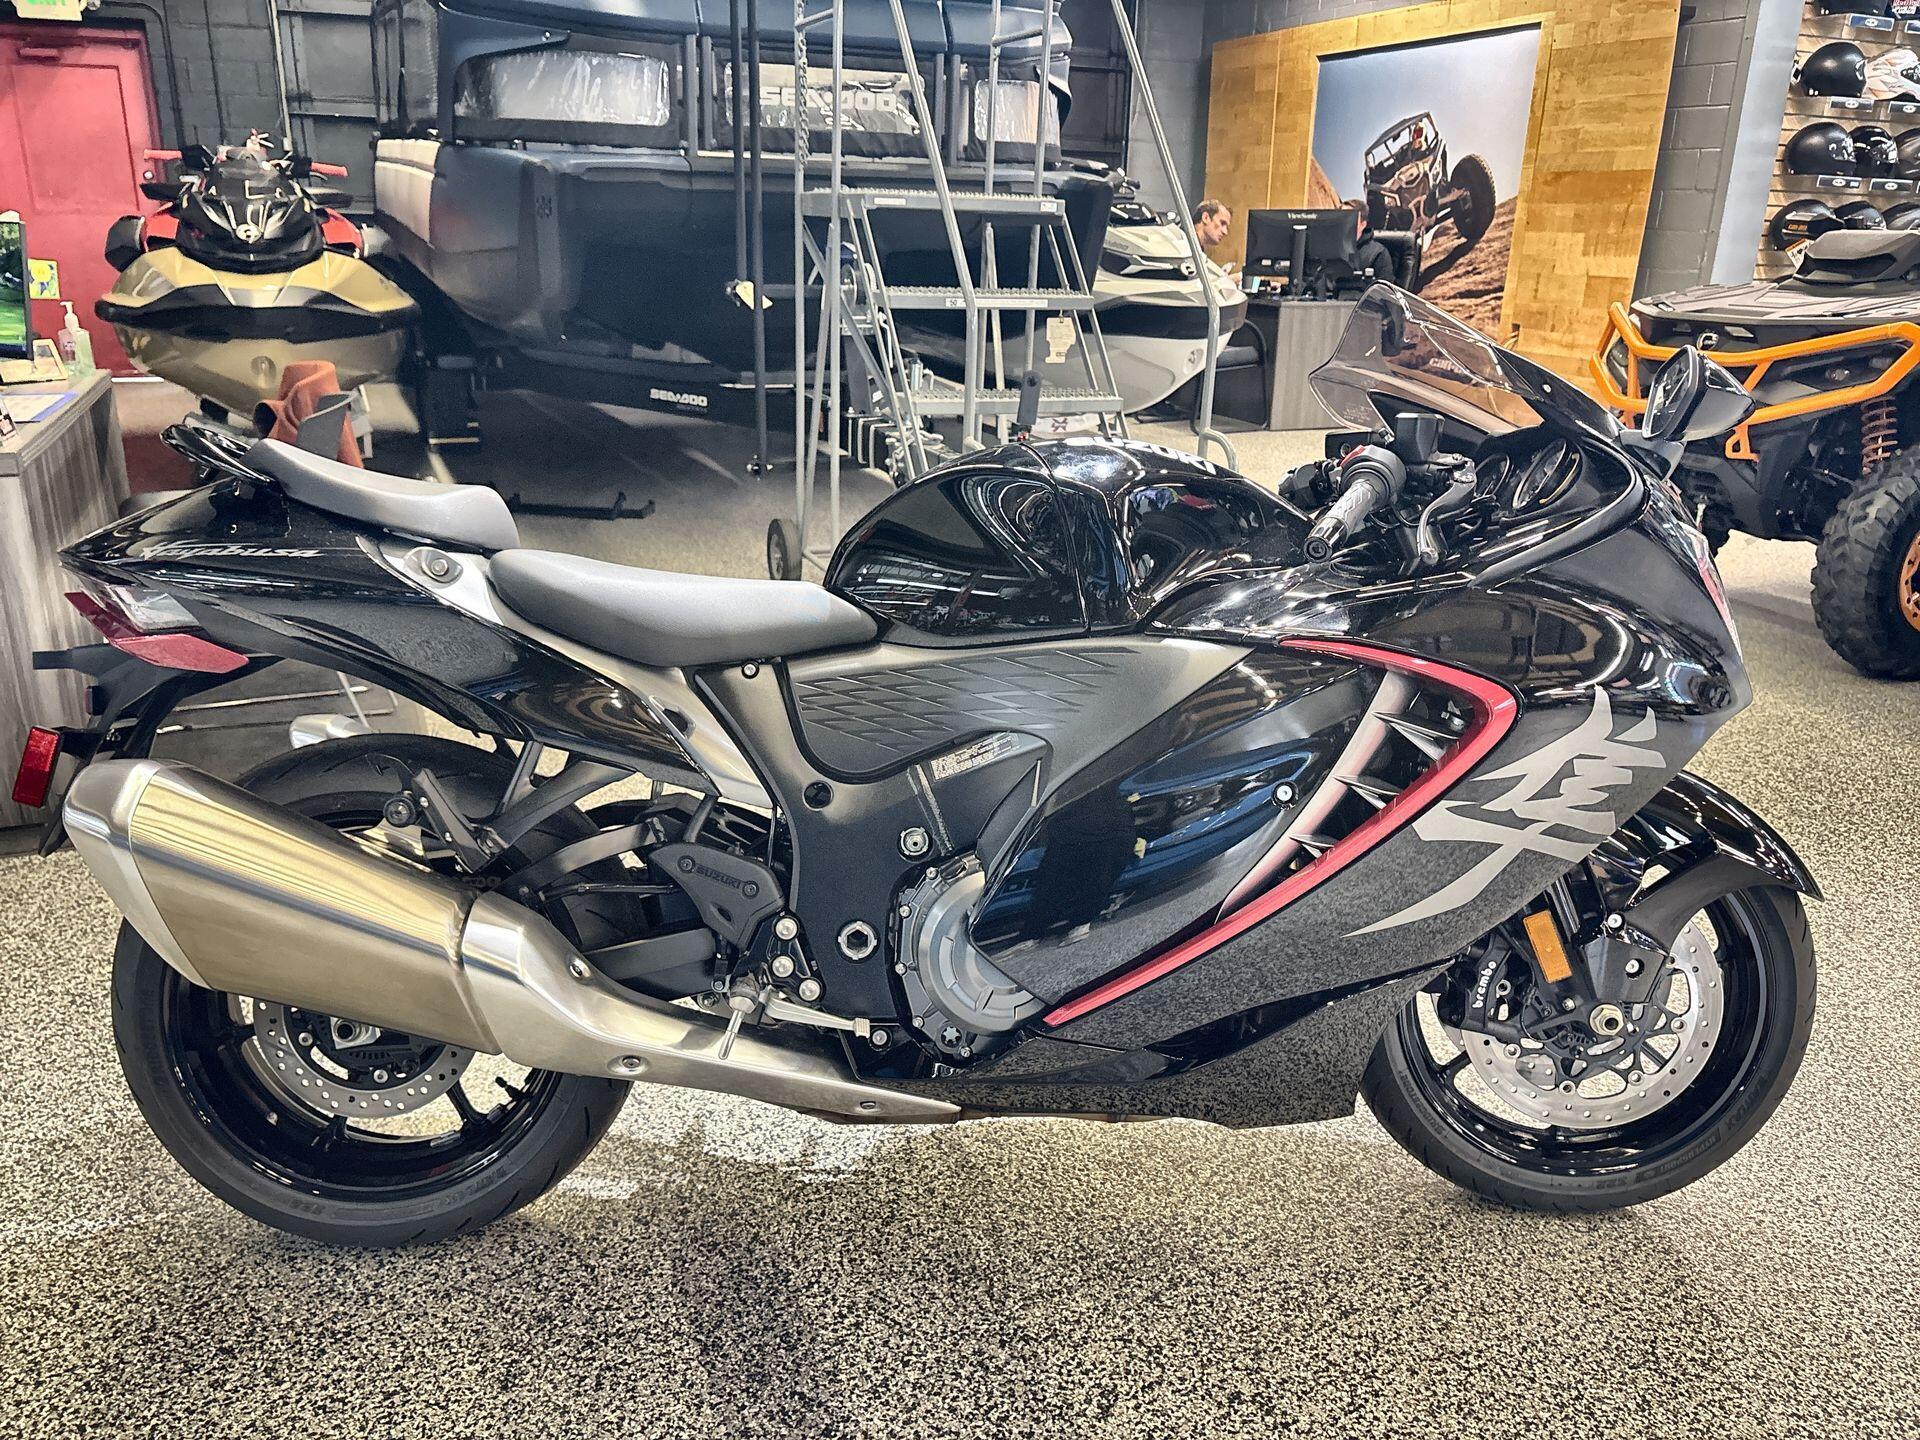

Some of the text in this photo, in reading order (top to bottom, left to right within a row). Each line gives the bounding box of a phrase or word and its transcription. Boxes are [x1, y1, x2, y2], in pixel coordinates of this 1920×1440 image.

[139, 539, 325, 561] Hayabusa
[696, 863, 741, 889] SUZUKI
[1471, 960, 1497, 1008] brembo
